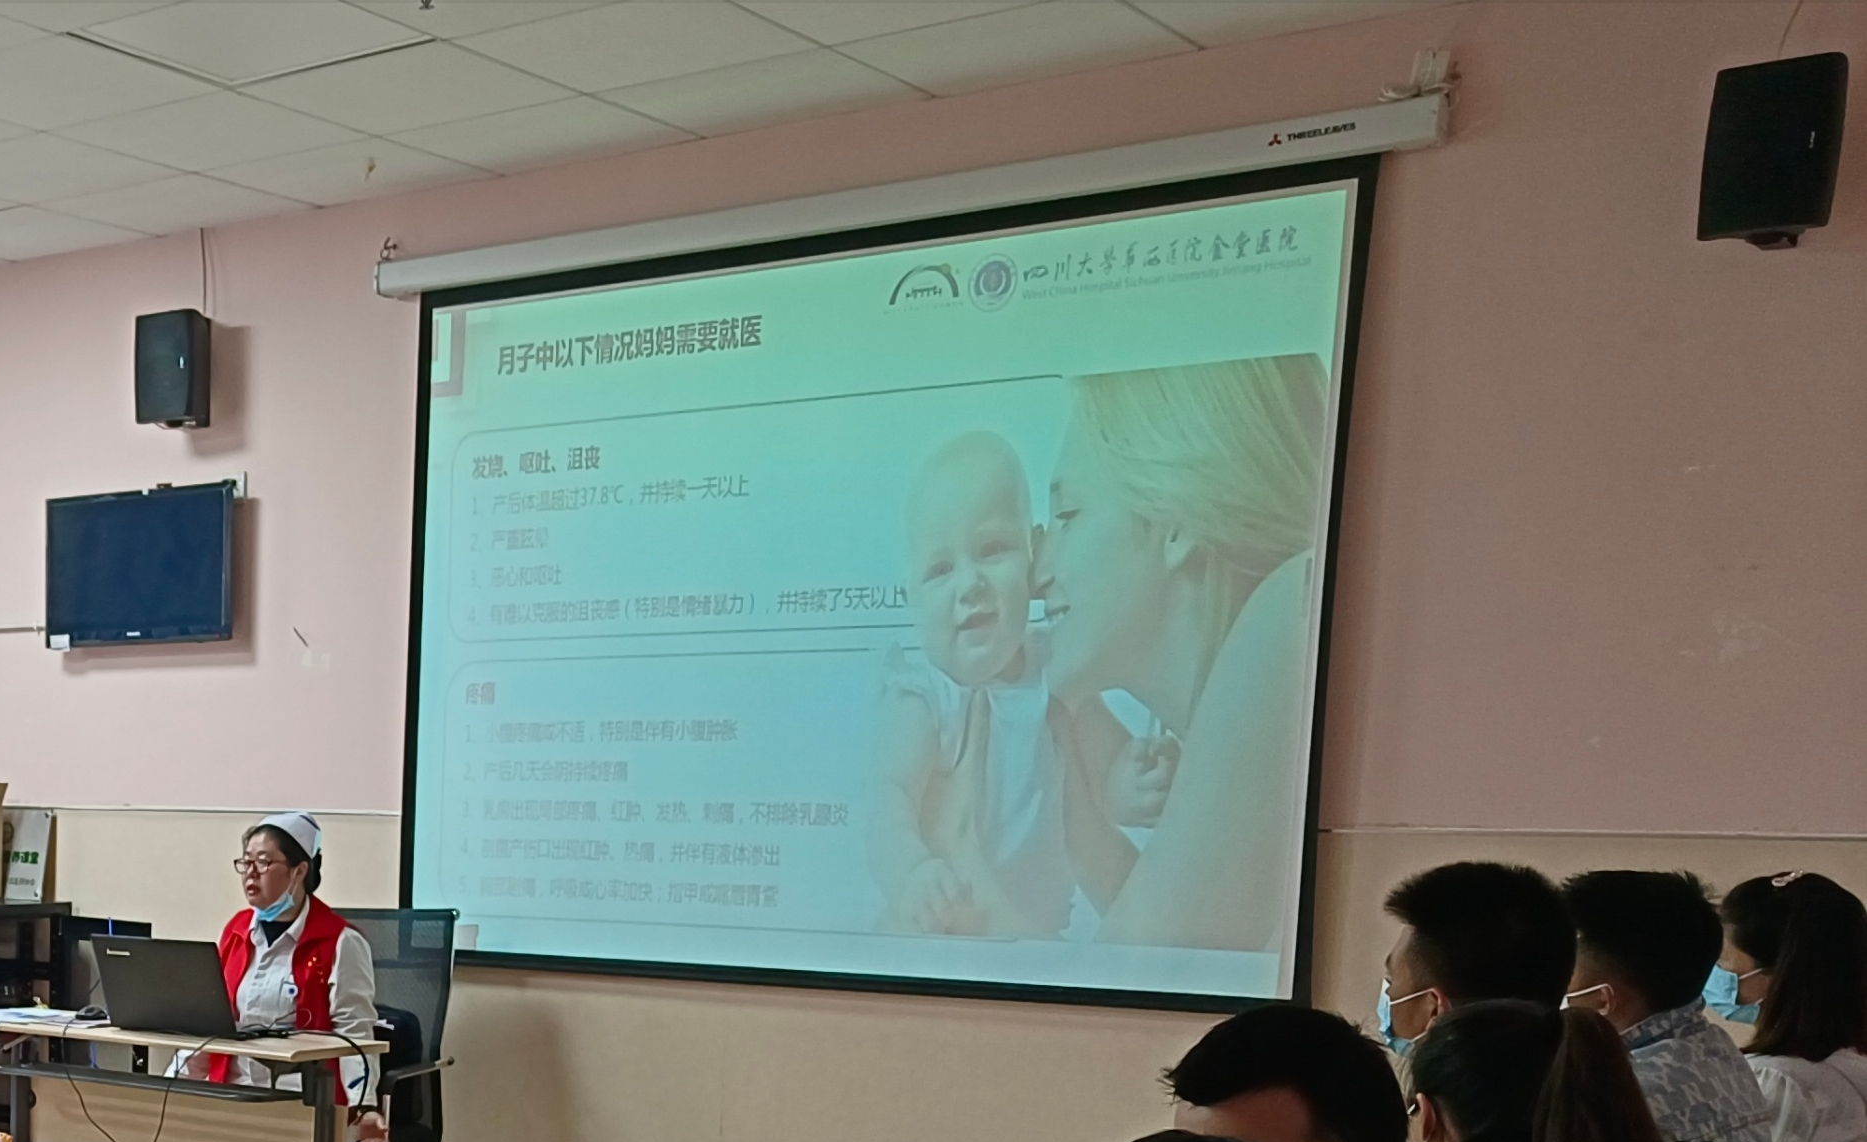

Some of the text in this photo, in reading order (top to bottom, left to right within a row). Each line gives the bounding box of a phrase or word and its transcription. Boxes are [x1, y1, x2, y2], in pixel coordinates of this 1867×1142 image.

[1286, 121, 1356, 142] THREELEAVES
[1080, 278, 1122, 295] Hospital
[1124, 274, 1164, 290] Sichuan
[498, 315, 763, 375] 月子中以下情况妈妈需要就医
